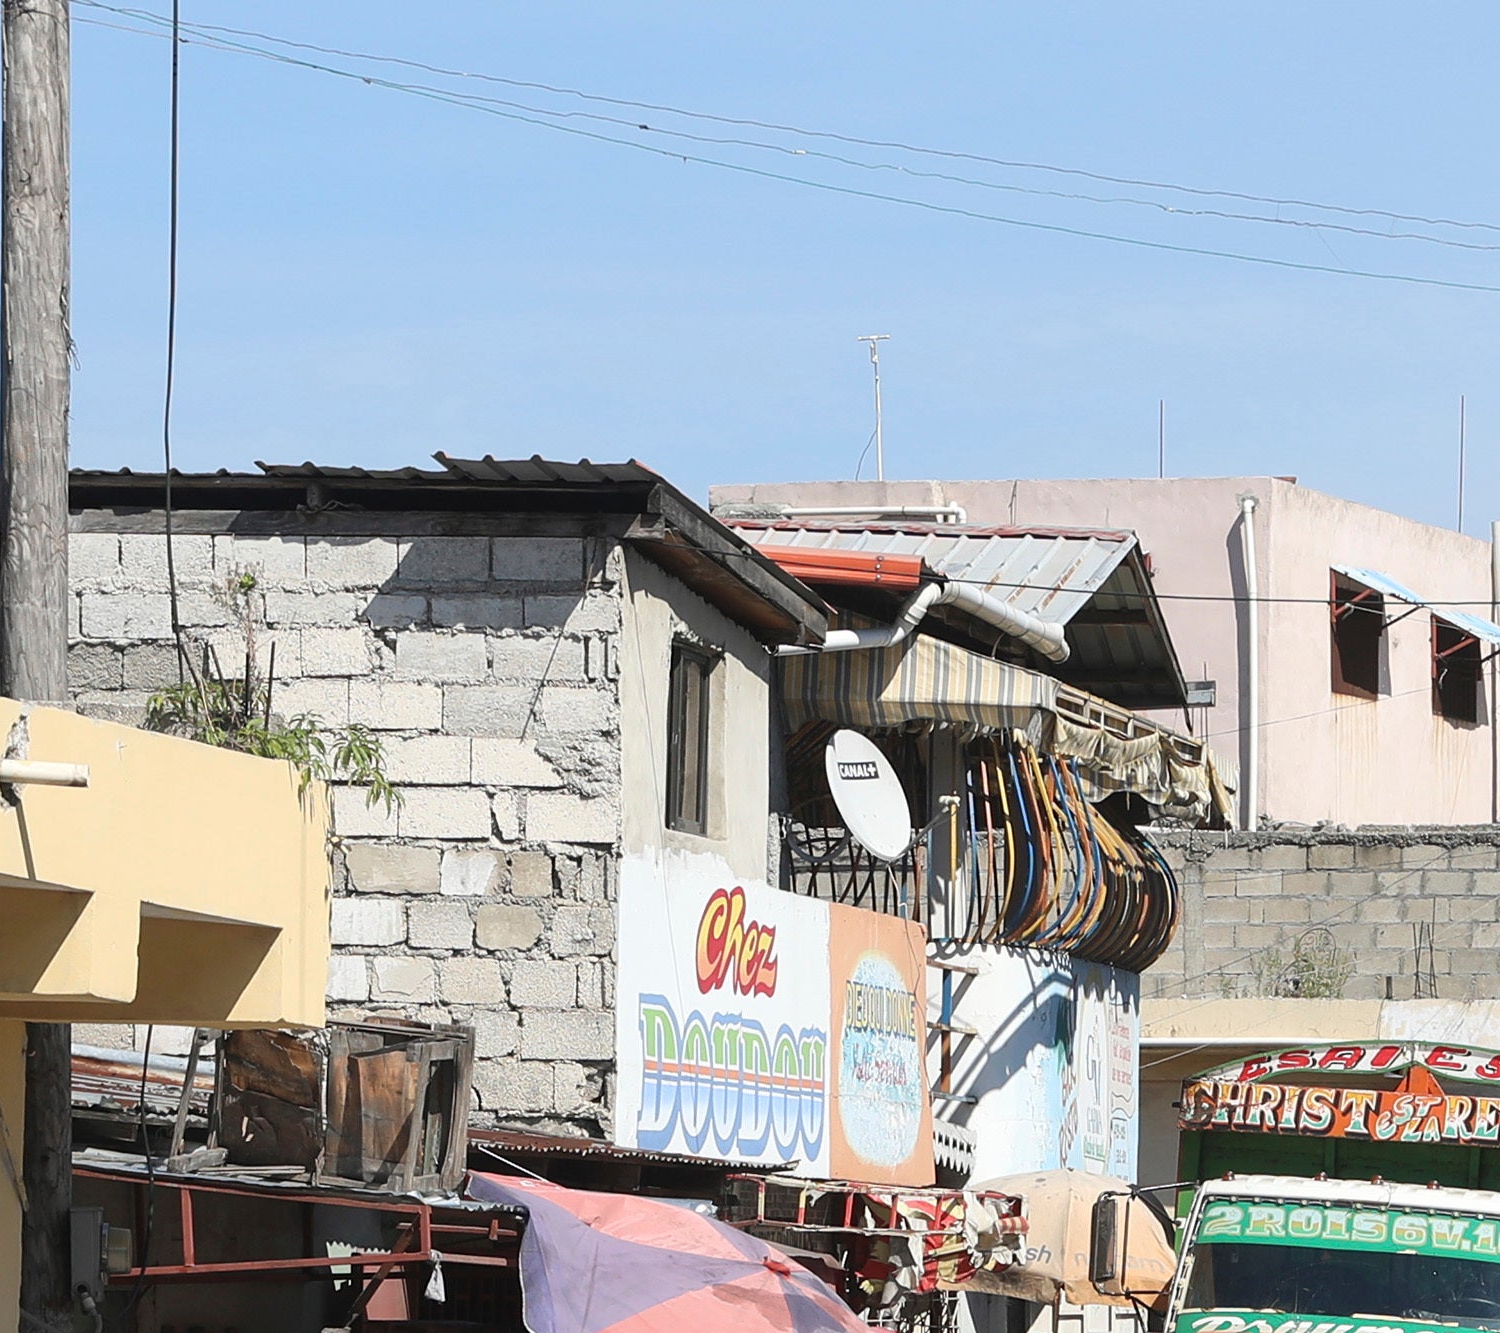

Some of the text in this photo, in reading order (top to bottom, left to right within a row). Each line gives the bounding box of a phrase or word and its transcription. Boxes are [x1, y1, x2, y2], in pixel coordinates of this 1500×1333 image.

[838, 763, 876, 778] CANAL+
[696, 887, 778, 998] Chez
[637, 993, 827, 1162] DOUDOU
[1238, 1045, 1468, 1083] ESAIE
[1182, 1079, 1376, 1134] CHRIST
[1245, 1206, 1388, 1243] ROIS
